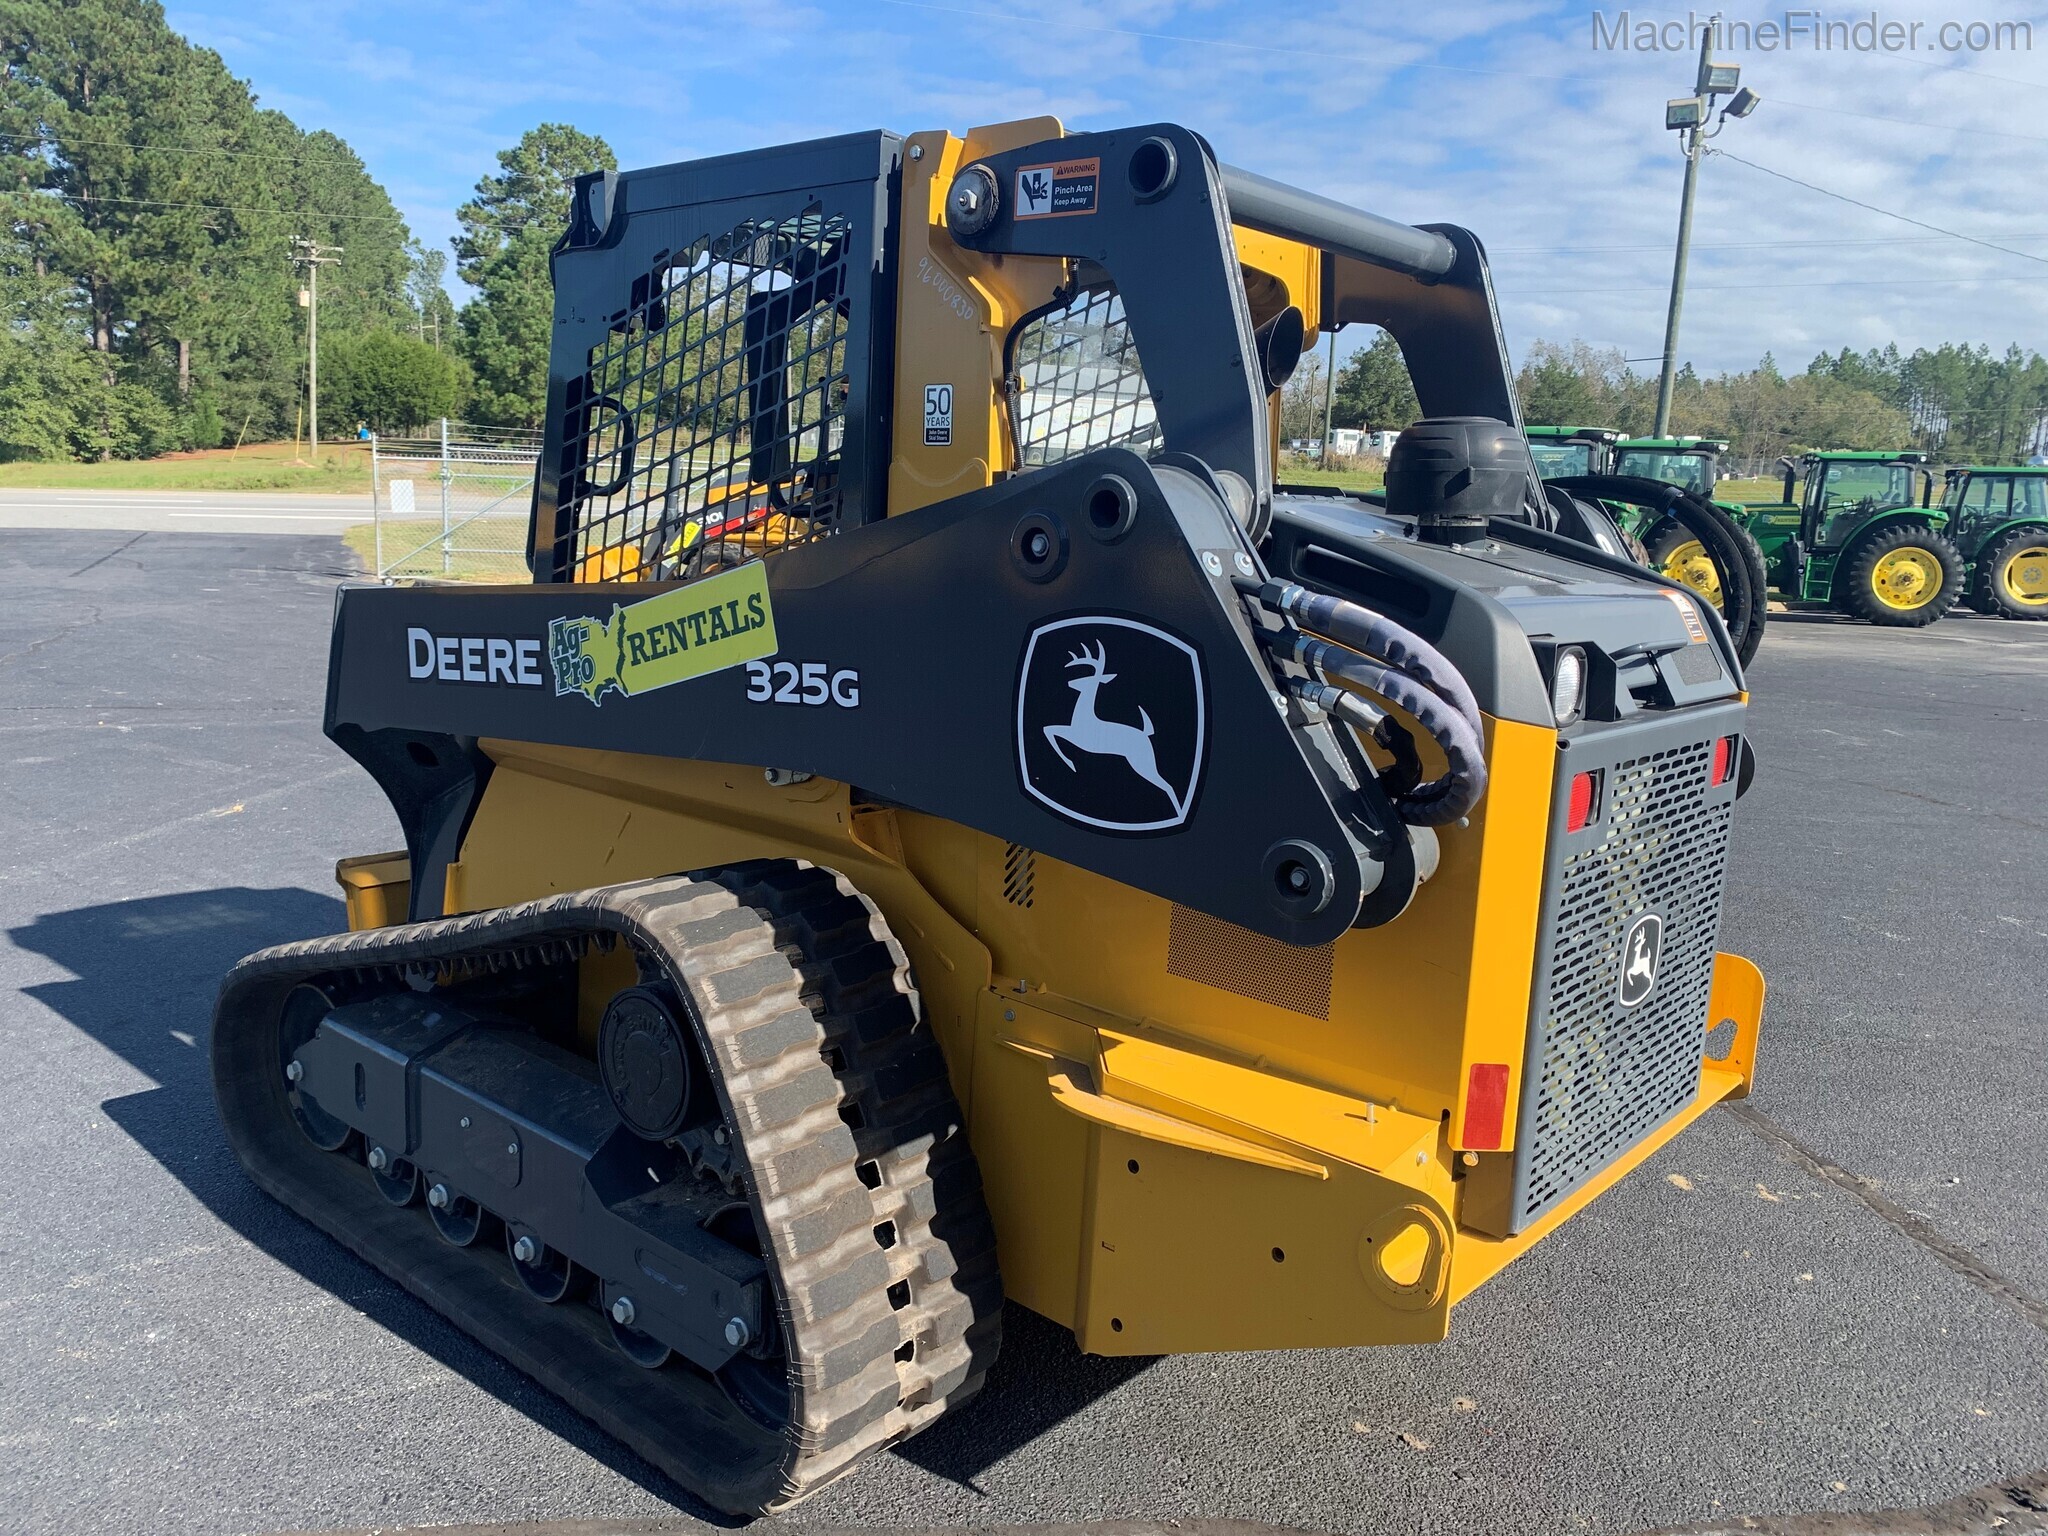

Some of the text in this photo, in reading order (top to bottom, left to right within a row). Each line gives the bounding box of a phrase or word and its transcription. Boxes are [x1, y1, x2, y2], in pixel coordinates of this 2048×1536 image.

[1064, 163, 1096, 175] WARNING
[1054, 184, 1093, 195] Pinch Area
[1054, 197, 1087, 206] Keep Away
[926, 387, 951, 416] 50
[926, 416, 950, 427] YEARS
[552, 621, 590, 660] Ag-
[626, 592, 766, 667] RENTALS
[407, 627, 543, 685] DEERE
[555, 654, 596, 692] Pro
[745, 660, 860, 708] 325G
